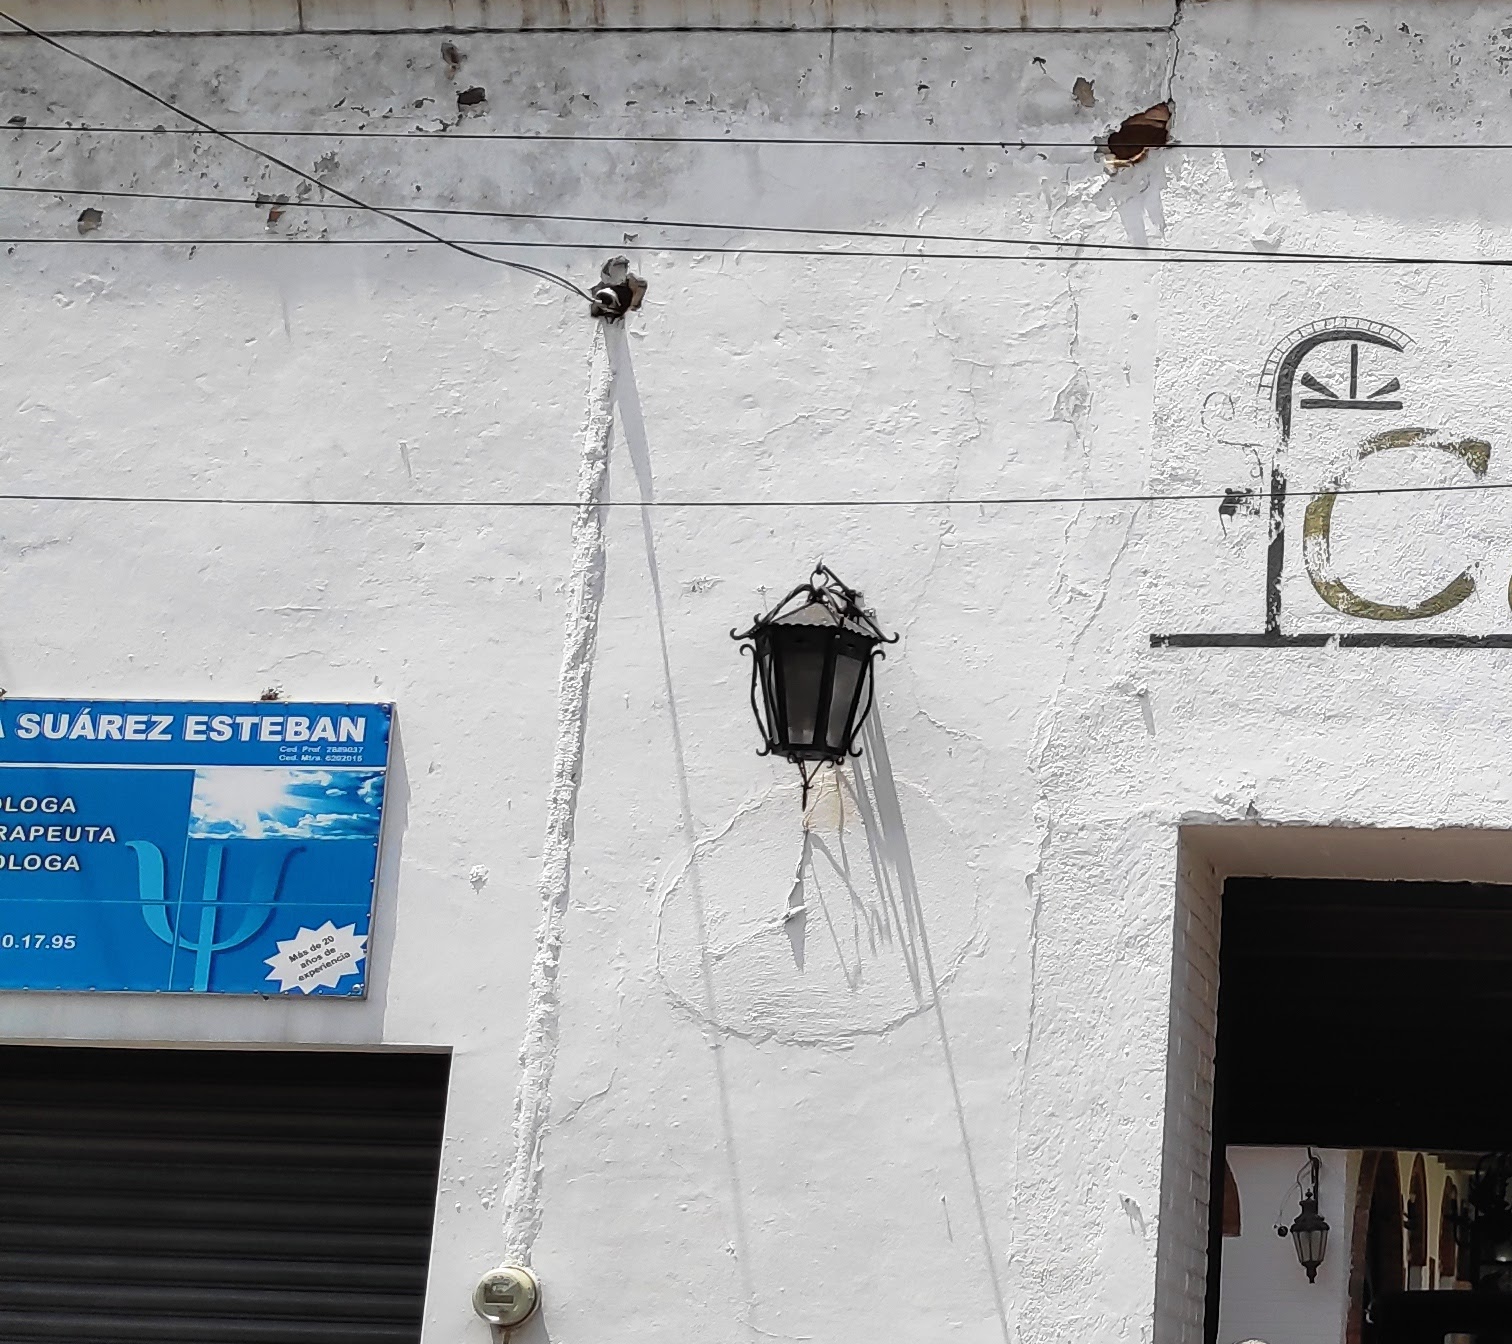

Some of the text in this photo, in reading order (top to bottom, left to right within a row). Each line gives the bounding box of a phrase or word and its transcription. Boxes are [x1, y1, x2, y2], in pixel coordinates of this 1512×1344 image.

[16, 707, 174, 741] SUÁREZ
[184, 713, 366, 743] ESTEBAN
[0, 796, 77, 814] LOGA
[1, 934, 77, 949] 0.17.95
[309, 942, 322, 952] de
[322, 935, 335, 946] 20
[298, 951, 352, 982] experiencia
[300, 946, 337, 970] años de
